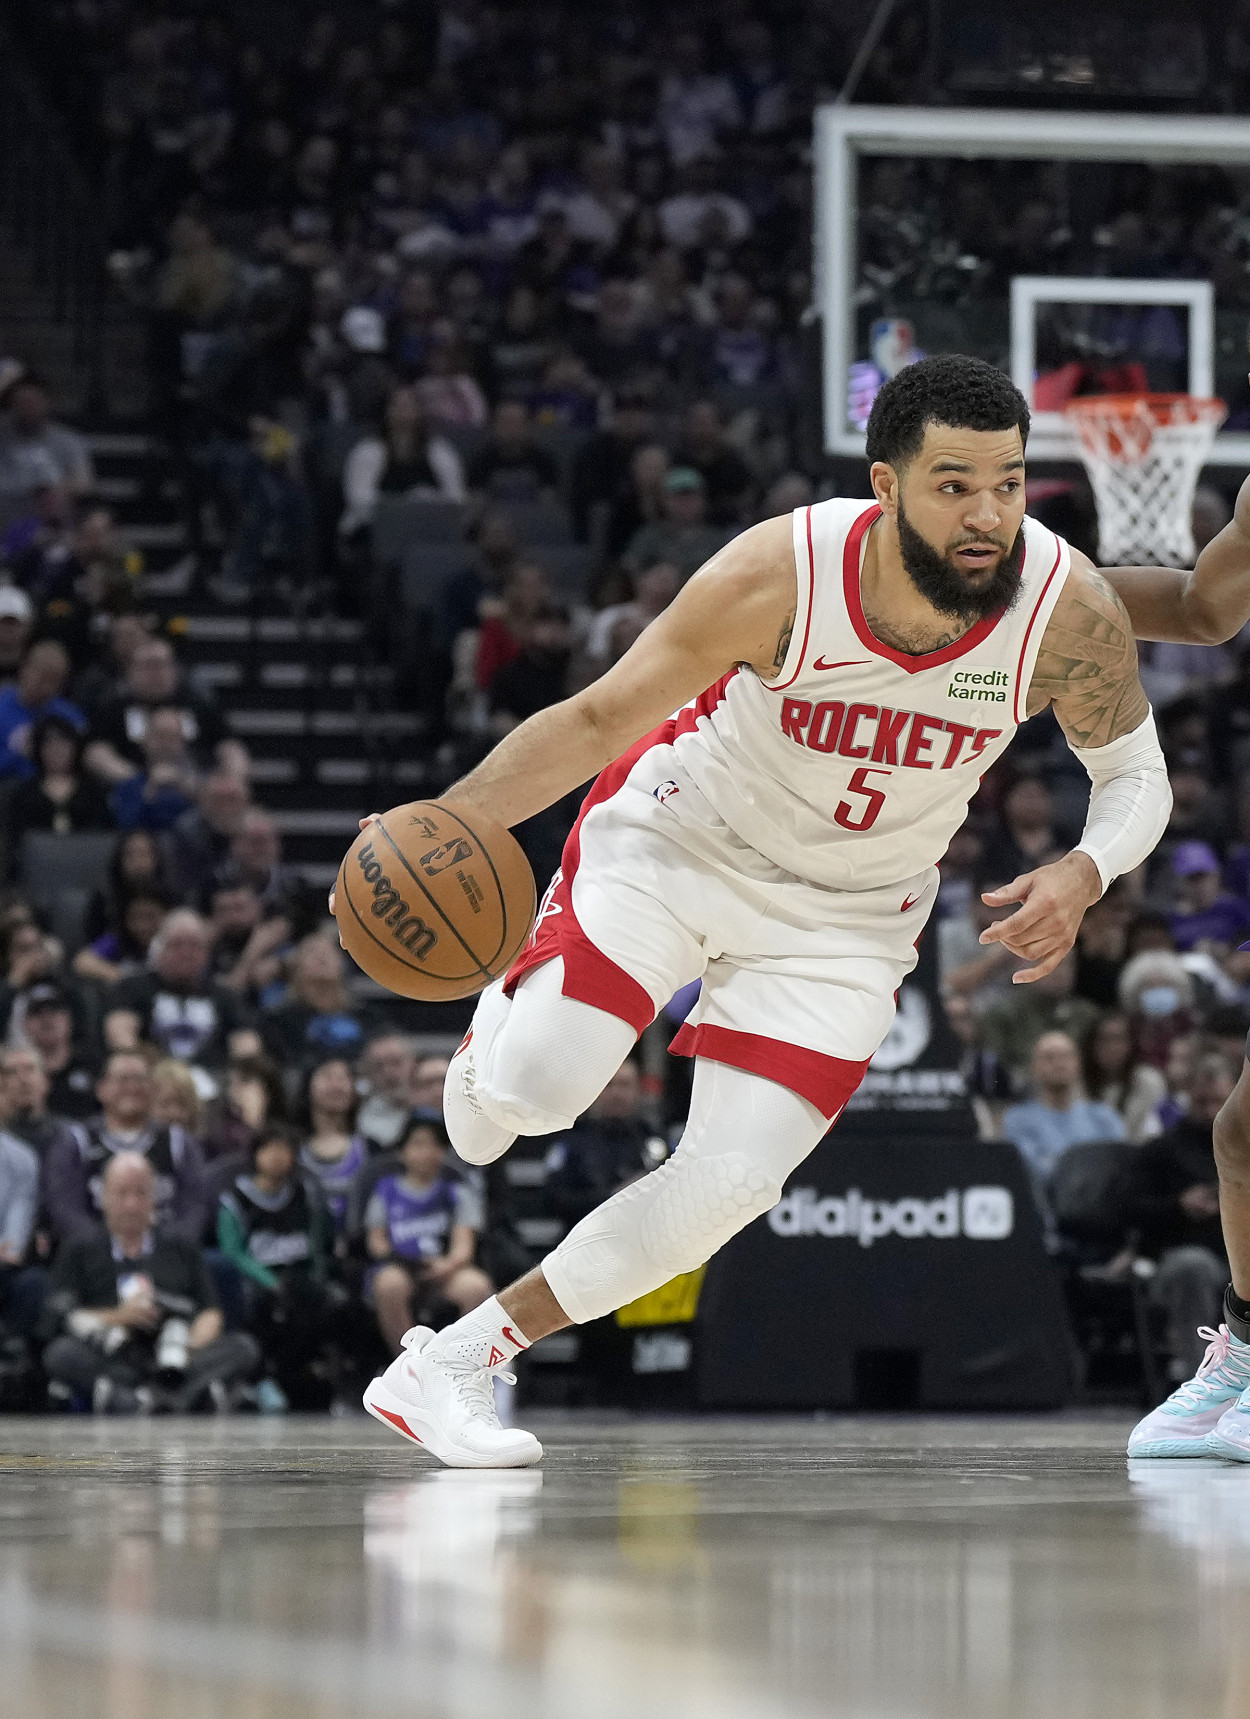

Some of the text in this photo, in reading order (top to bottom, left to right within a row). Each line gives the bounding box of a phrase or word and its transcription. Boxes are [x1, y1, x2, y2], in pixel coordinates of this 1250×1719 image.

[948, 684, 1007, 702] karma
[954, 670, 1009, 686] credit
[780, 696, 1003, 769] ROCKETS
[834, 767, 892, 831] 5
[357, 841, 438, 963] Wilson
[768, 1187, 961, 1248] dialpad
